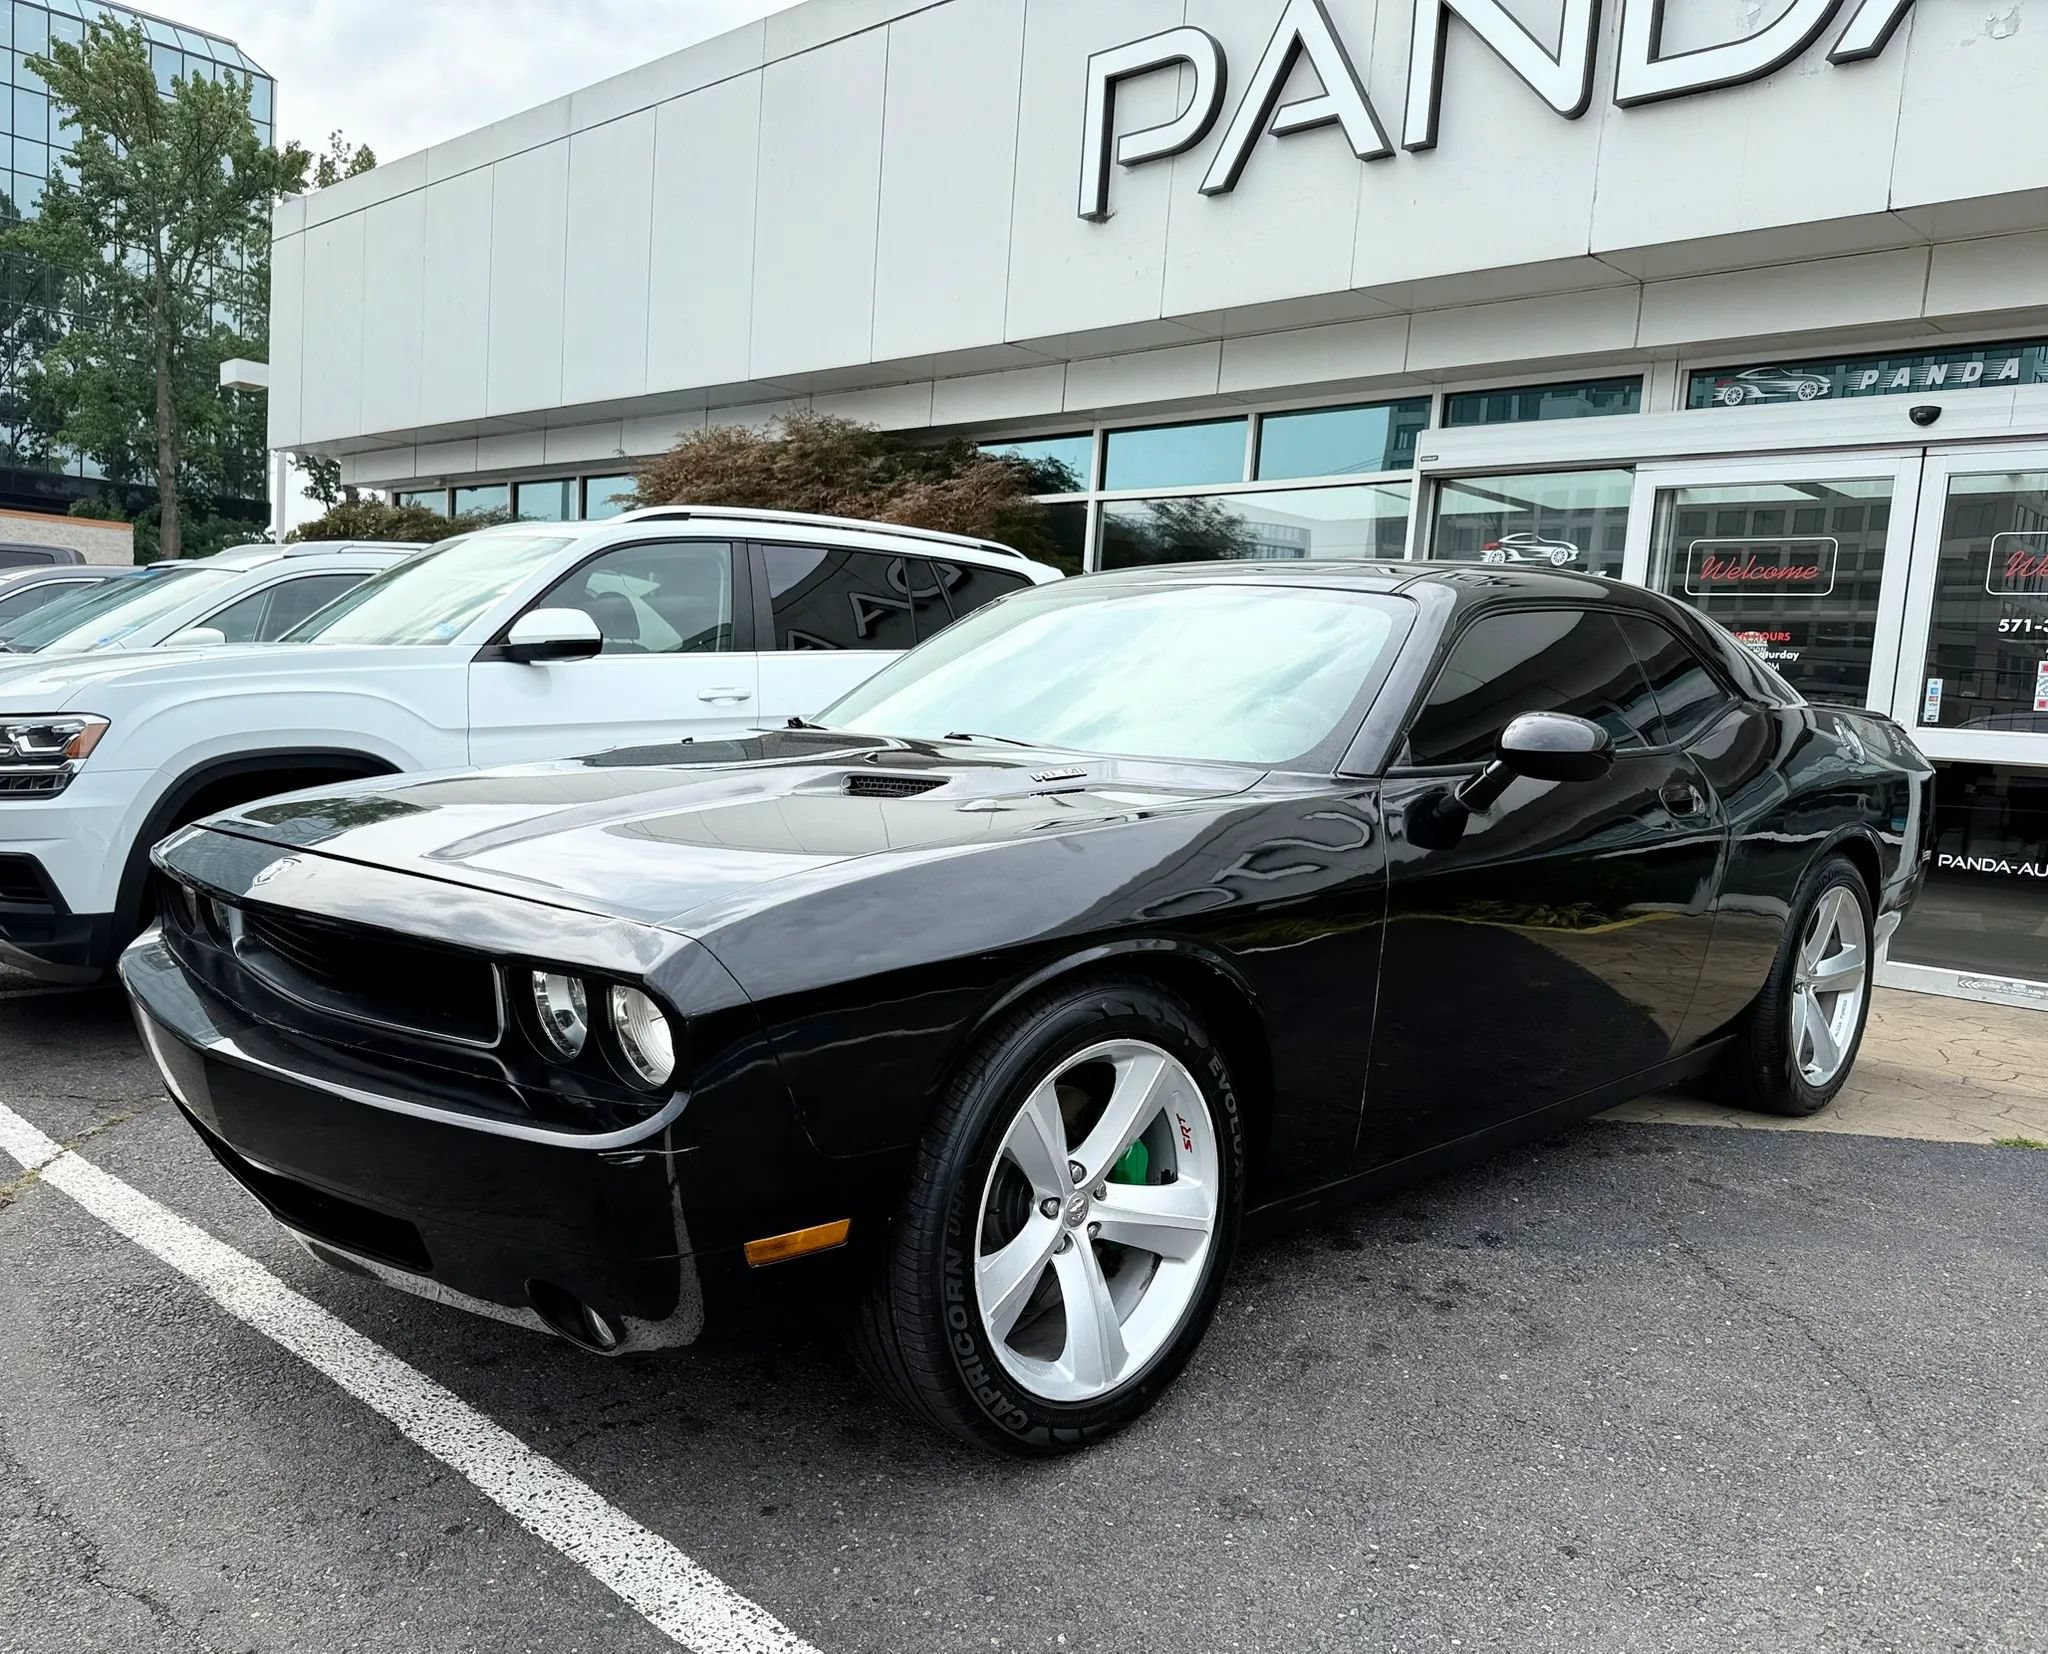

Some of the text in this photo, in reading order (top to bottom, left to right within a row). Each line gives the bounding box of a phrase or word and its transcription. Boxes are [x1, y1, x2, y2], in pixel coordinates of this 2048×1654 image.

[1850, 357, 2020, 390] PANDA
[1699, 555, 1820, 580] Welcome
[1758, 650, 1799, 661] aturday
[1176, 1113, 1193, 1154] SRT
[945, 1247, 1029, 1431] CAPRICORN
